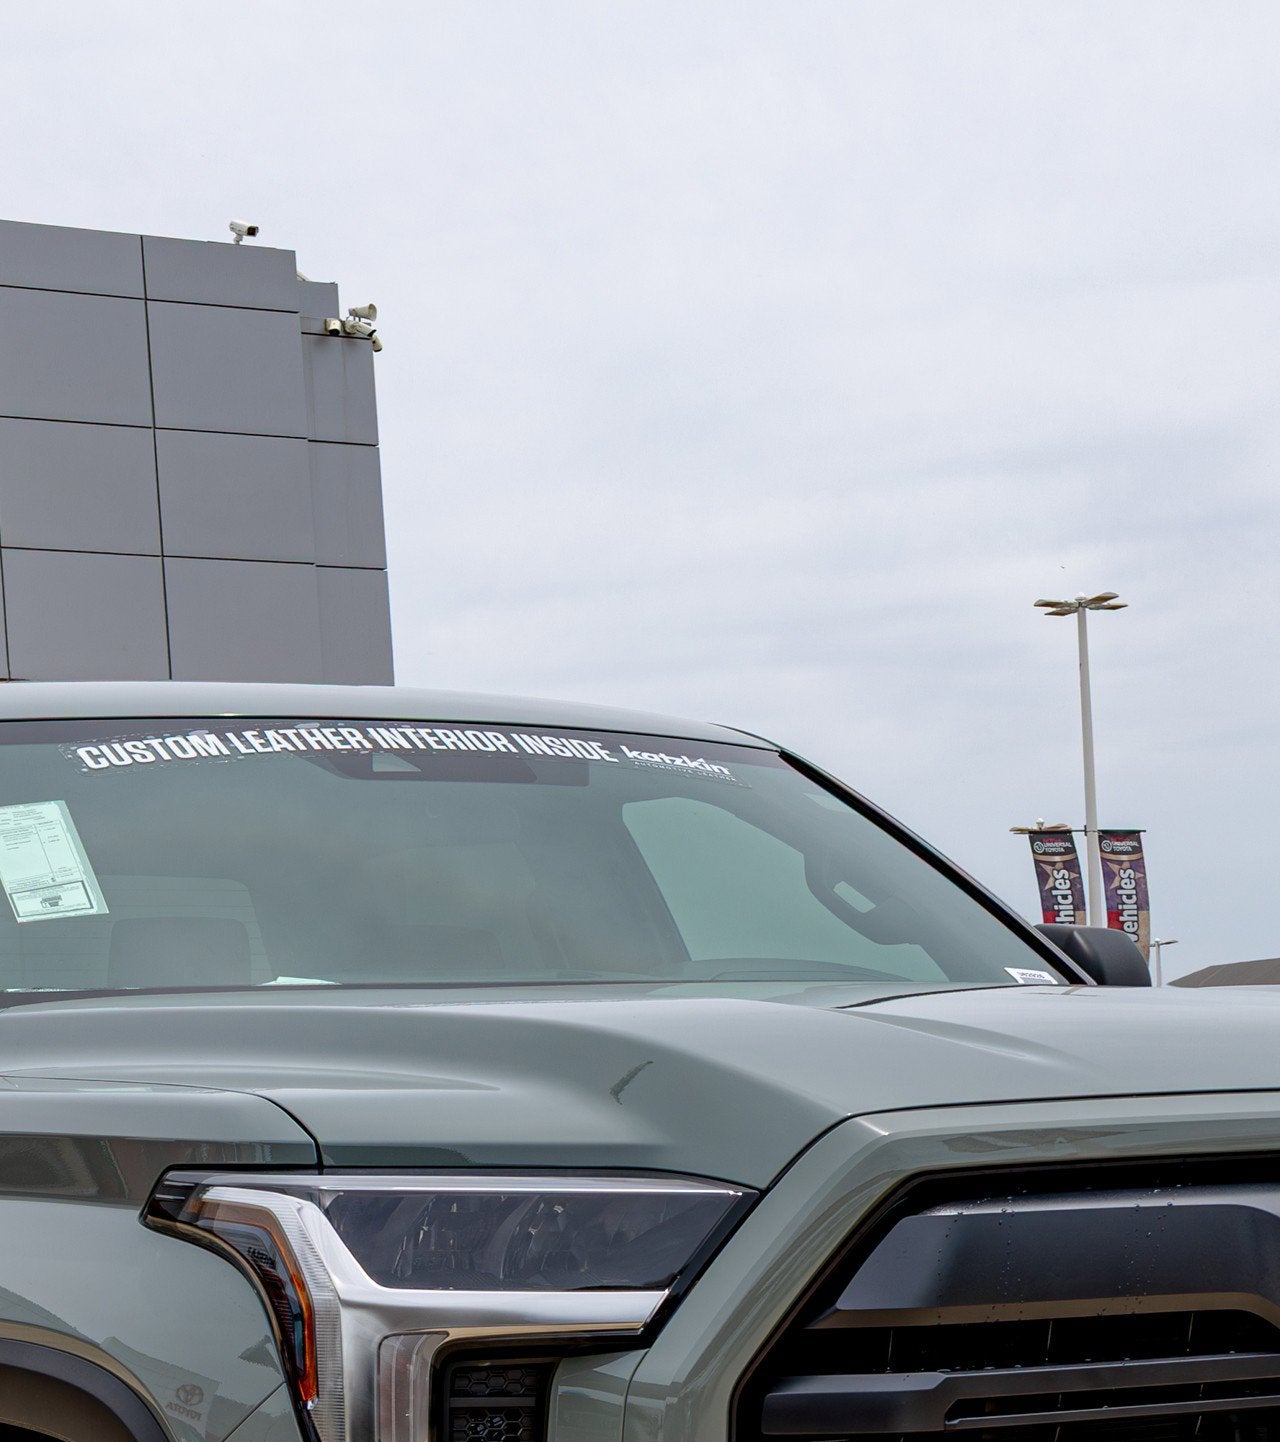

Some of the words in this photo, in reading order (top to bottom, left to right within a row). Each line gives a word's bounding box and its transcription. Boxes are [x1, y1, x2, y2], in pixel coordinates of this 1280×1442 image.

[76, 732, 231, 770] CUSTOM
[225, 727, 372, 754] LEATHER
[366, 727, 519, 753] INTERIOR
[509, 733, 619, 762] INSIDE
[620, 744, 731, 775] katzkin
[1051, 869, 1075, 924] hicles
